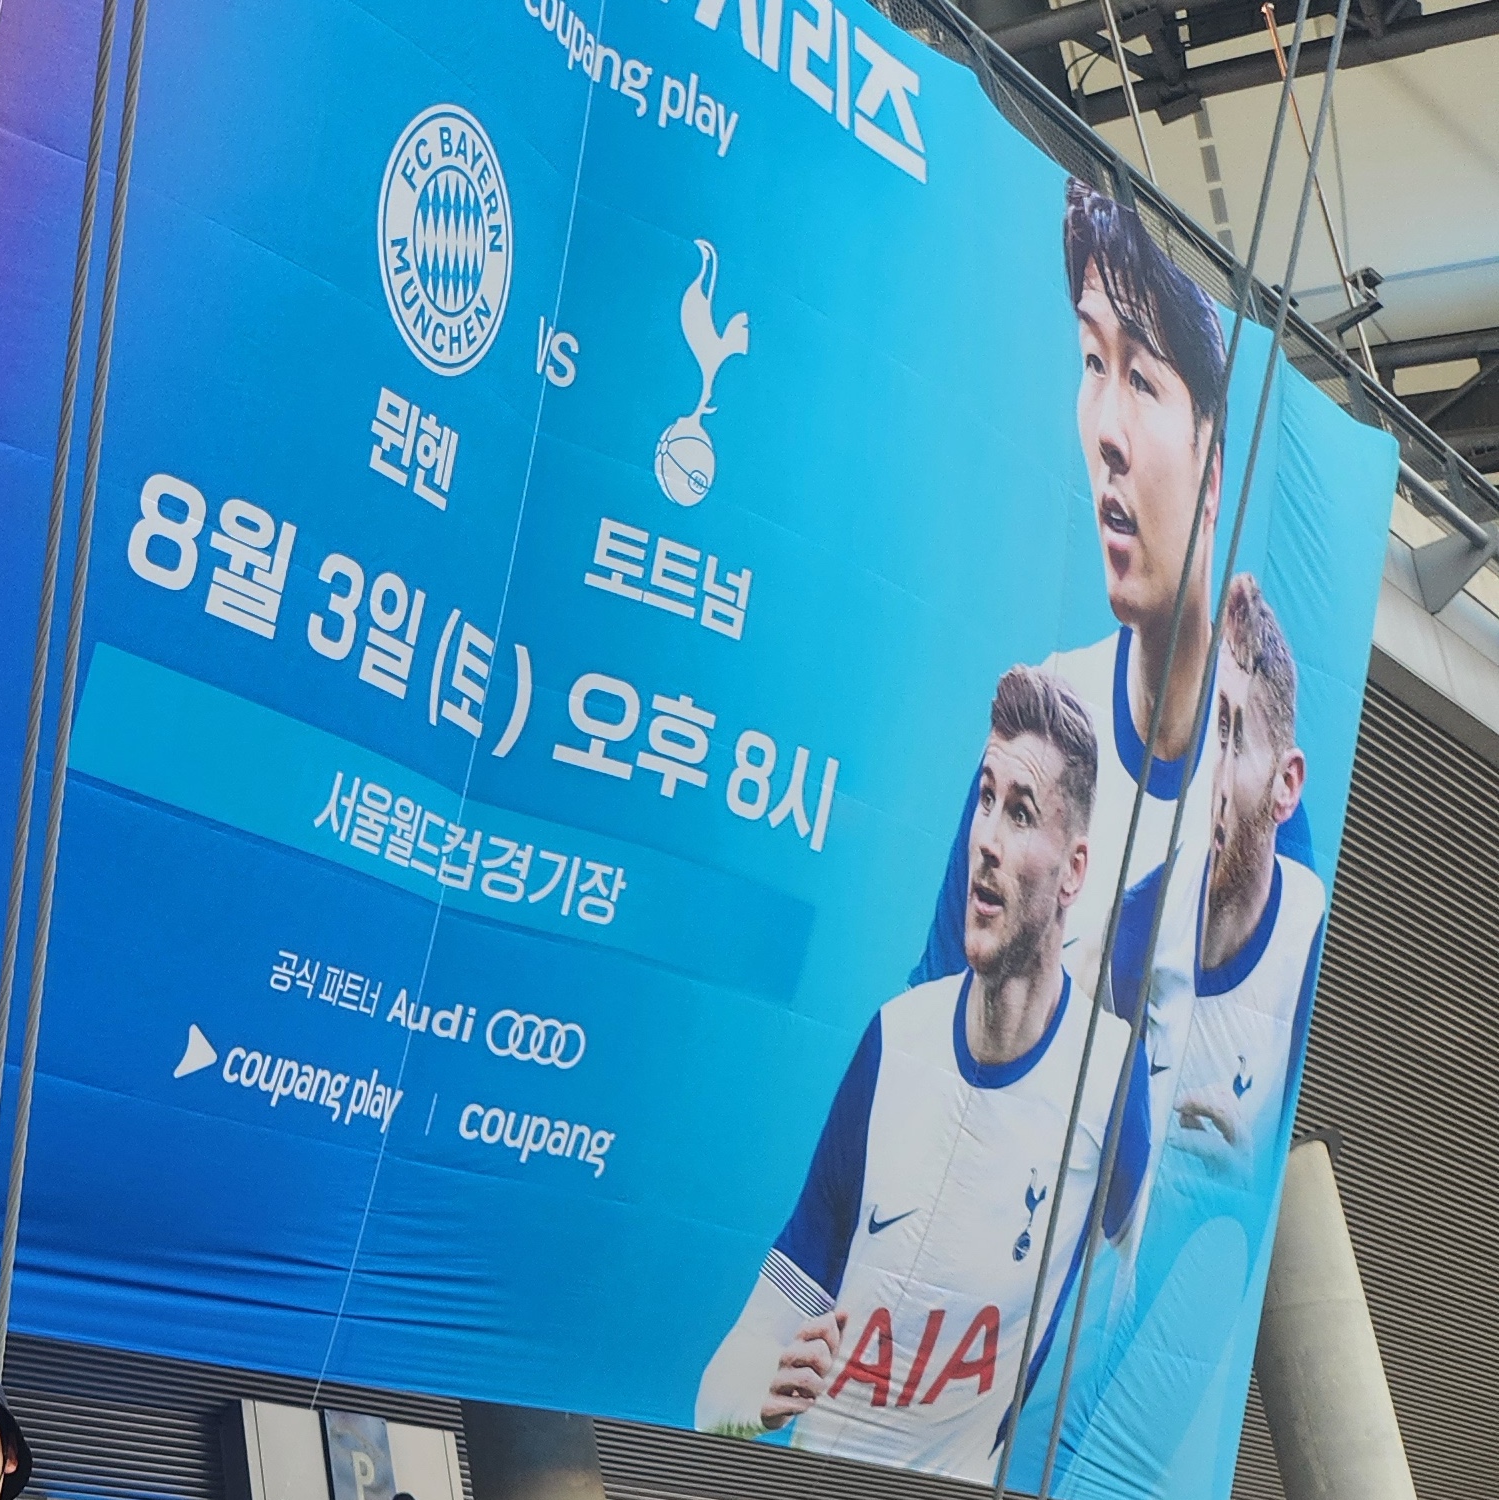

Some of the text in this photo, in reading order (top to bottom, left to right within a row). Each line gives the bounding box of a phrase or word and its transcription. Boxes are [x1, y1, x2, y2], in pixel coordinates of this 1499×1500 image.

[658, 73, 739, 158] play
[401, 126, 503, 253] FC BAYERN
[369, 386, 459, 511] 뮌헨
[583, 517, 752, 641] 토트넘
[127, 473, 297, 640] 8월
[552, 672, 716, 799] 오후
[726, 730, 839, 853] 8시
[269, 949, 477, 1043] 공식 파트너 Audi
[221, 1045, 616, 1178] coupang play coupang
[827, 1304, 1001, 1408] AIA
